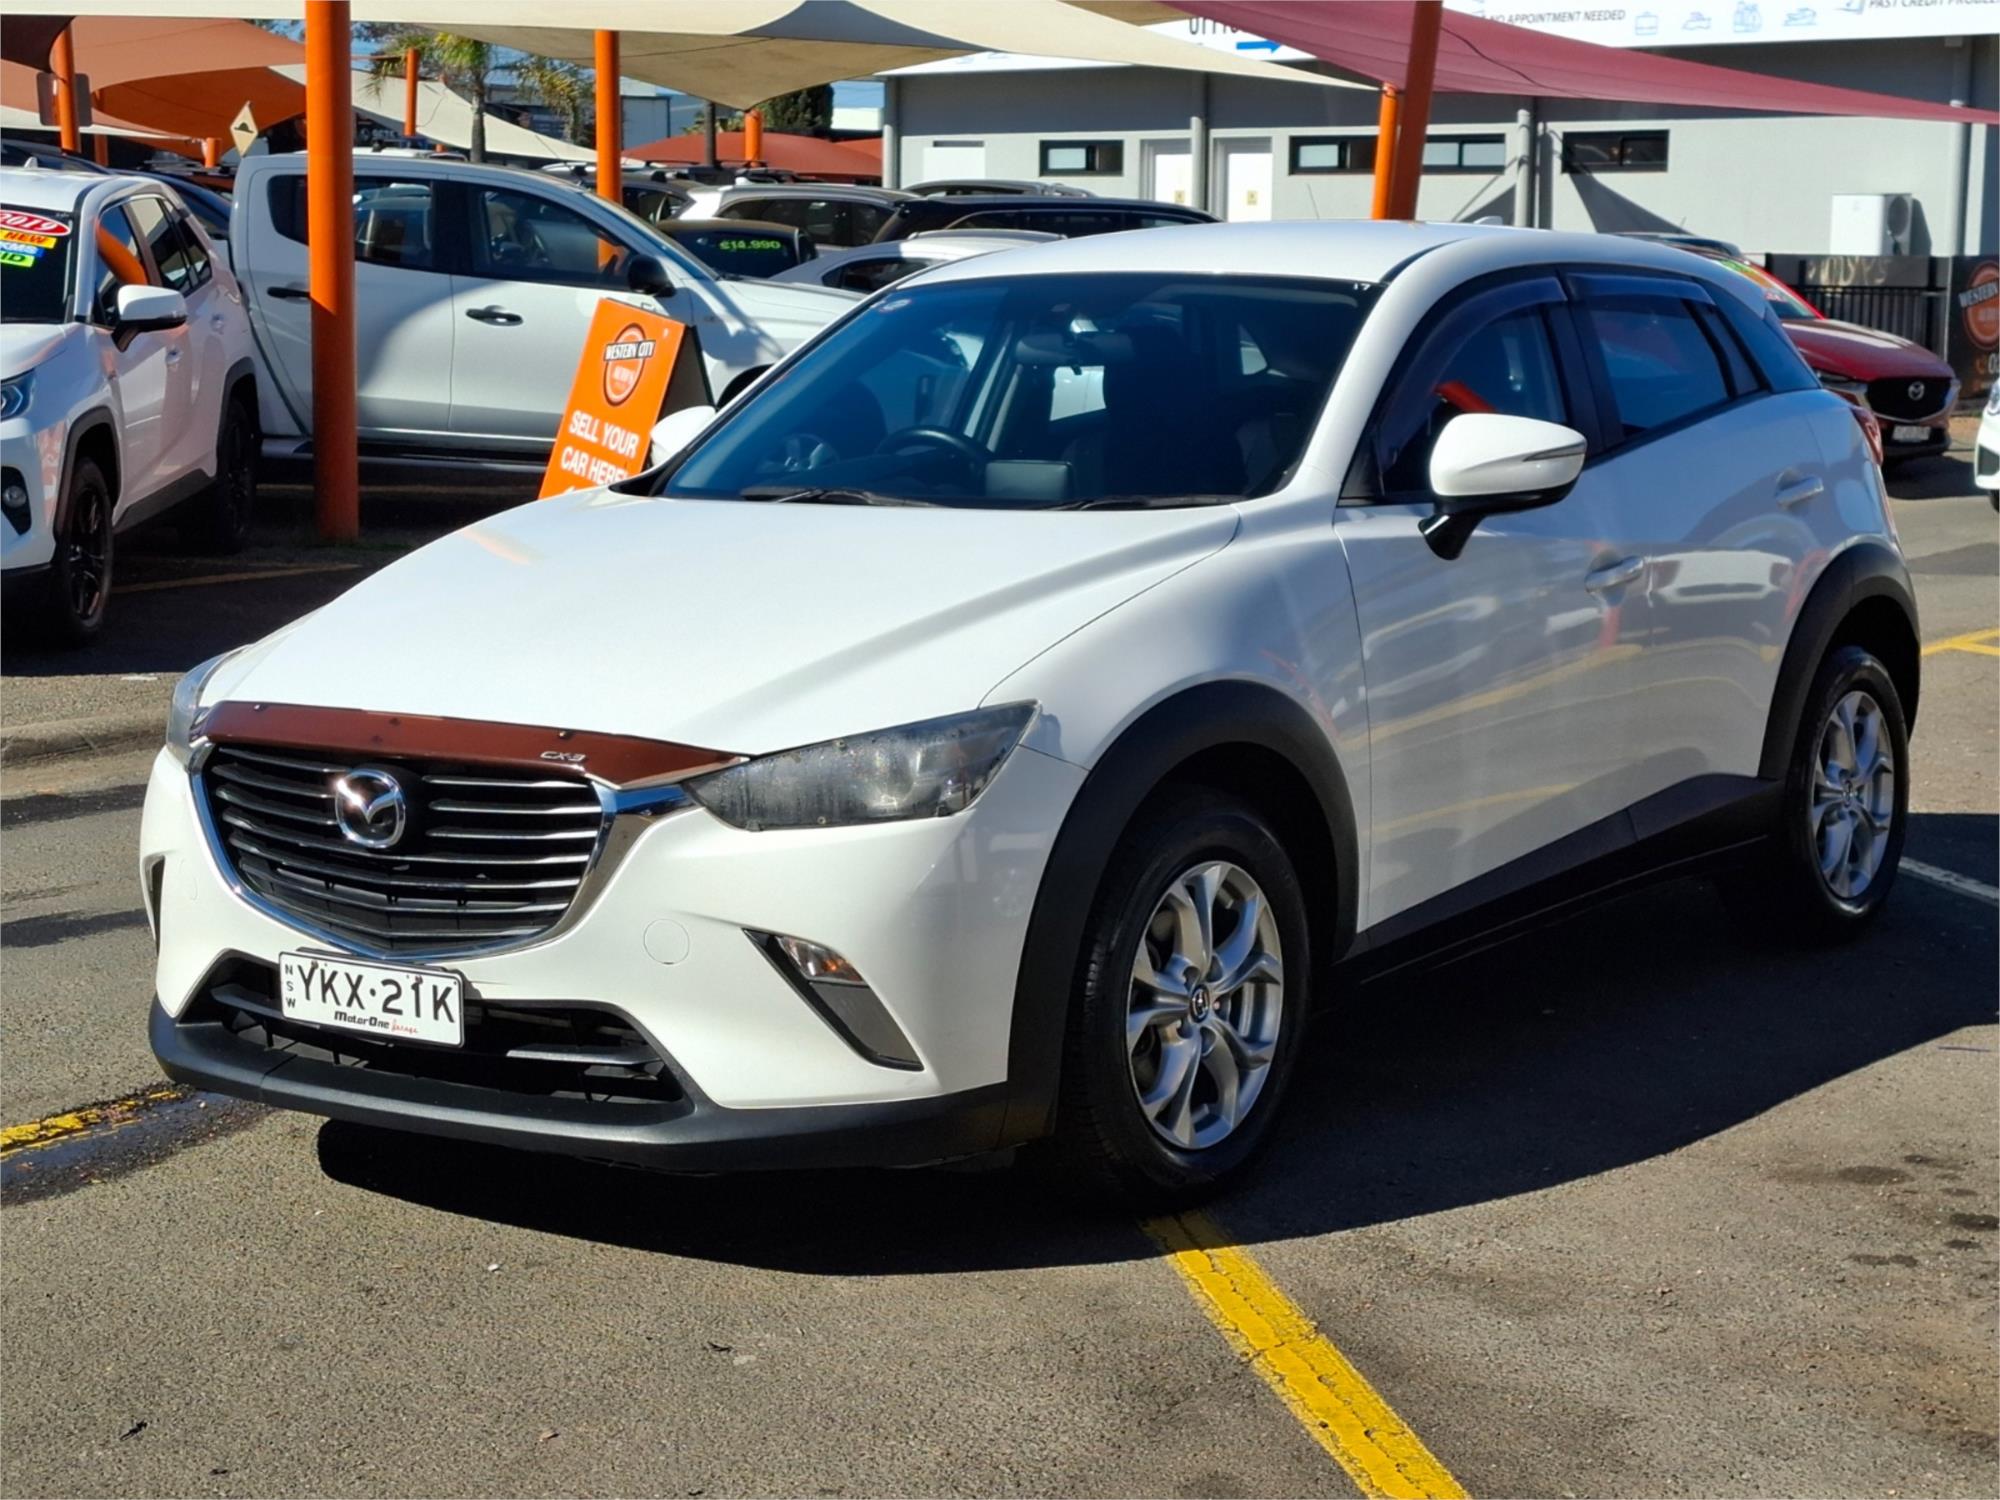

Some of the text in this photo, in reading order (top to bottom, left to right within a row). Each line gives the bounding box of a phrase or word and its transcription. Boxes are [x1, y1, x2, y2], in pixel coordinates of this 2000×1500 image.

[1508, 11, 1581, 24] APPOINTMENT
[1584, 9, 1626, 21] NEEDED
[4, 230, 48, 244] NEW
[605, 341, 656, 360] WESTERN CITY
[569, 410, 640, 459] SELL YOUR
[561, 446, 589, 477] CAR
